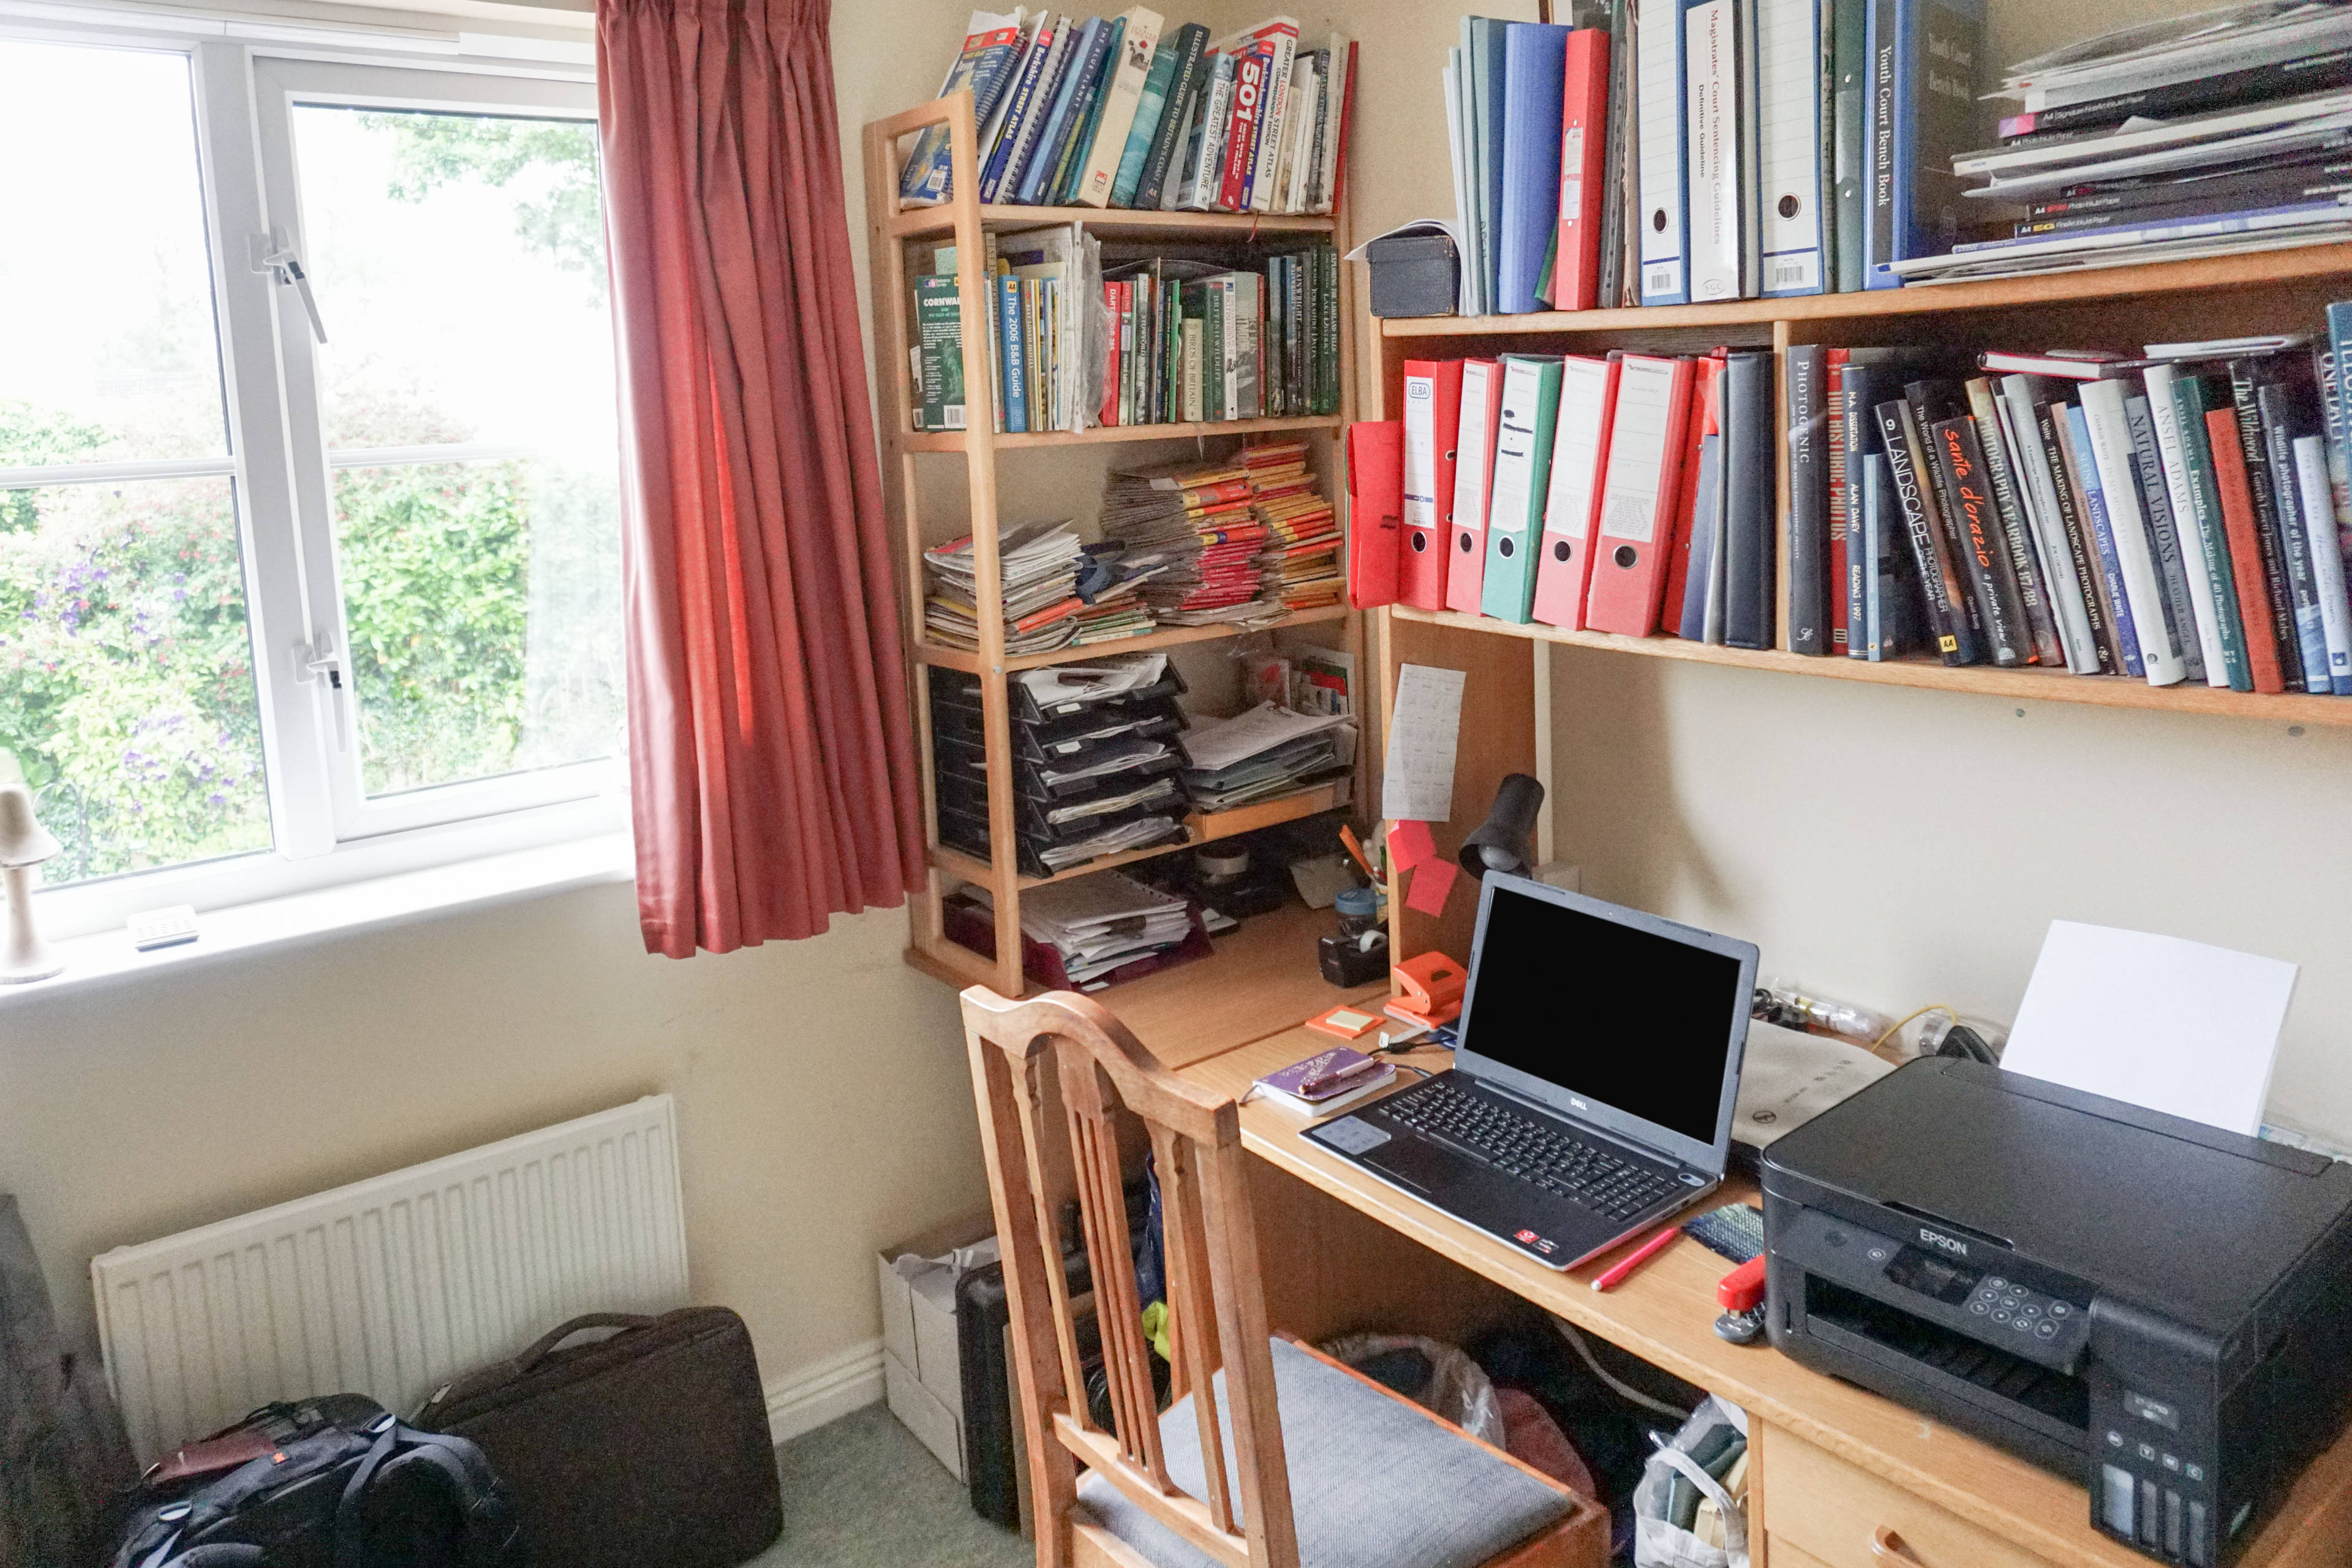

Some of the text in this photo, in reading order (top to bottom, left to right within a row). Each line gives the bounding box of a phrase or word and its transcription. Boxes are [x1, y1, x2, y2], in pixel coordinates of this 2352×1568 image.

[1024, 46, 1046, 86] Berkshire
[1183, 29, 1203, 82] ILLUSTRATED
[1708, 9, 1719, 78] Magistrates'
[1072, 26, 1109, 108] THE BLUE PLANET
[1013, 86, 1029, 114] STREET
[1170, 107, 1180, 118] TO
[1174, 81, 1188, 106] GUIDE
[1236, 61, 1261, 121] 501
[1264, 39, 1292, 178] GREATER LONDON STREET ATLAS
[1267, 68, 1281, 120] COMPREHENSIVE
[1004, 114, 1019, 140] ATLAS
[1200, 82, 1225, 189] THE GREATEST ADVENTURE
[1245, 56, 1270, 175] Buckinghamshire STREET ATLAS
[1878, 46, 1891, 206] Youth Court Bench Book
[1710, 116, 1721, 180] Sentencing
[1705, 282, 1723, 292] SGC
[1008, 296, 1021, 398] The 2006 B&B Guide
[1189, 360, 1196, 371] OF
[1411, 386, 1427, 396] ELBA
[1797, 361, 1811, 462] PHOTOGENIC
[2234, 378, 2253, 402] The
[1848, 391, 1858, 451] M.A. DISSERTATION
[1886, 419, 1896, 431] 9
[1916, 405, 1926, 421] The
[1920, 421, 1932, 444] World
[2238, 404, 2265, 462] Wildwood
[1926, 444, 1934, 453] of
[2158, 405, 2189, 513] ANSEL ADAMS
[2275, 426, 2288, 460] Wildlife
[1828, 420, 1846, 540] HISTORIC PHOTOS
[1886, 436, 1930, 545] LANDSCAPE
[1930, 461, 1944, 488] Wildlife
[2132, 415, 2174, 563] NATURAL VISIONS
[2278, 463, 2297, 522] photographer
[1850, 508, 1859, 533] DAVEY
[1936, 489, 1957, 540] Photographer
[1944, 429, 1993, 567] sante d'orazio
[1977, 415, 2038, 607] PHOTOGRAPHY YEARBOOK 87/88
[2040, 418, 2100, 630] Waite THE MAKING OF LANDSCAPE PHOTOGRAPHS
[2087, 491, 2111, 555] LANDSCAPES
[2202, 525, 2211, 539] The
[1920, 563, 1929, 579] THE
[2204, 540, 2217, 572] Making
[2292, 541, 2302, 558] the
[2294, 562, 2307, 581] year
[1852, 565, 1861, 620] READING 1997
[1924, 548, 1948, 613] PHOTOGRAPHER
[1924, 579, 1935, 601] YEAR
[1981, 579, 2002, 617] private
[2106, 573, 2124, 617] CHARLIE WAITE
[2213, 583, 2222, 592] 40
[2214, 594, 2229, 640] Photographs
[1571, 1098, 1587, 1110] DELL
[1920, 1228, 1967, 1256] EPSON
